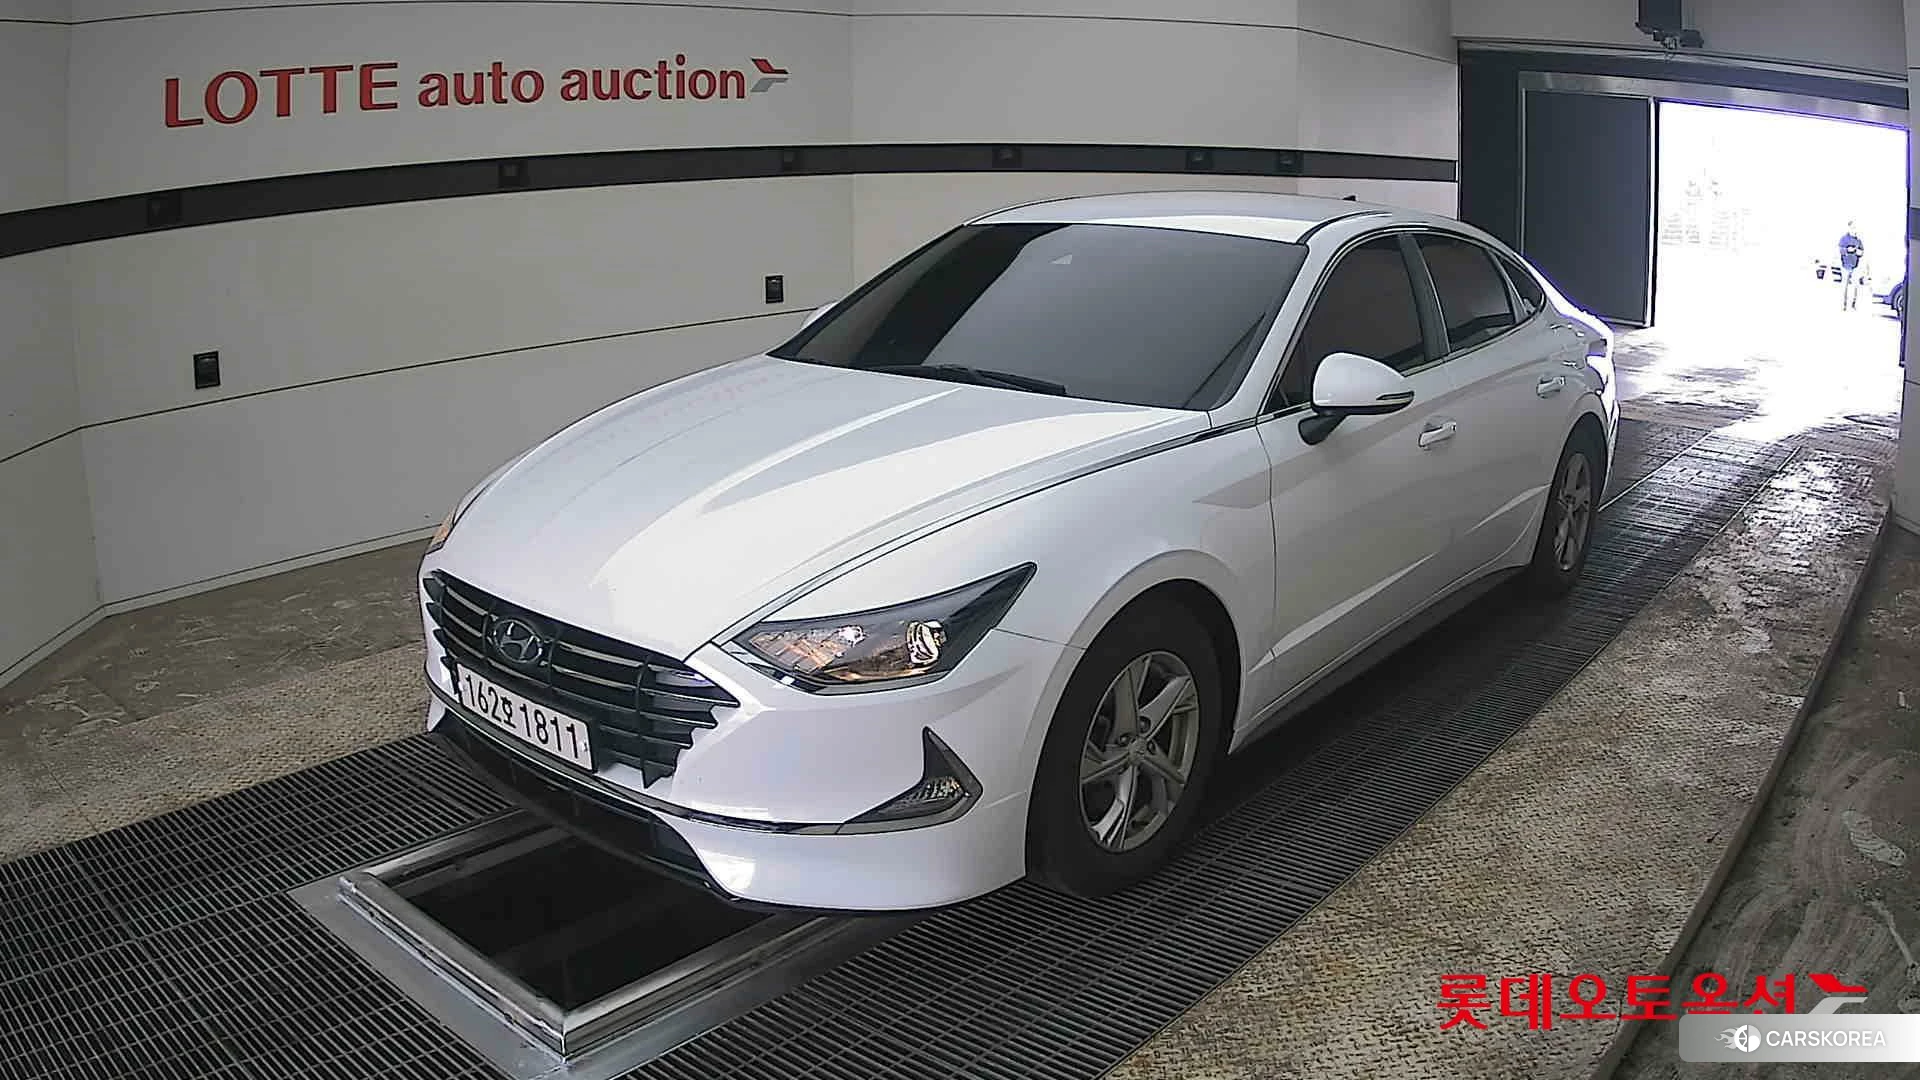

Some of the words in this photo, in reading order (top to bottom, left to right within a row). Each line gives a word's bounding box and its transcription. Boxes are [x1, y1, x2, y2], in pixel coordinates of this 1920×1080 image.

[165, 62, 399, 128] LOTTE
[418, 61, 545, 107] auto
[560, 54, 746, 101] auction
[520, 702, 579, 759] 1811
